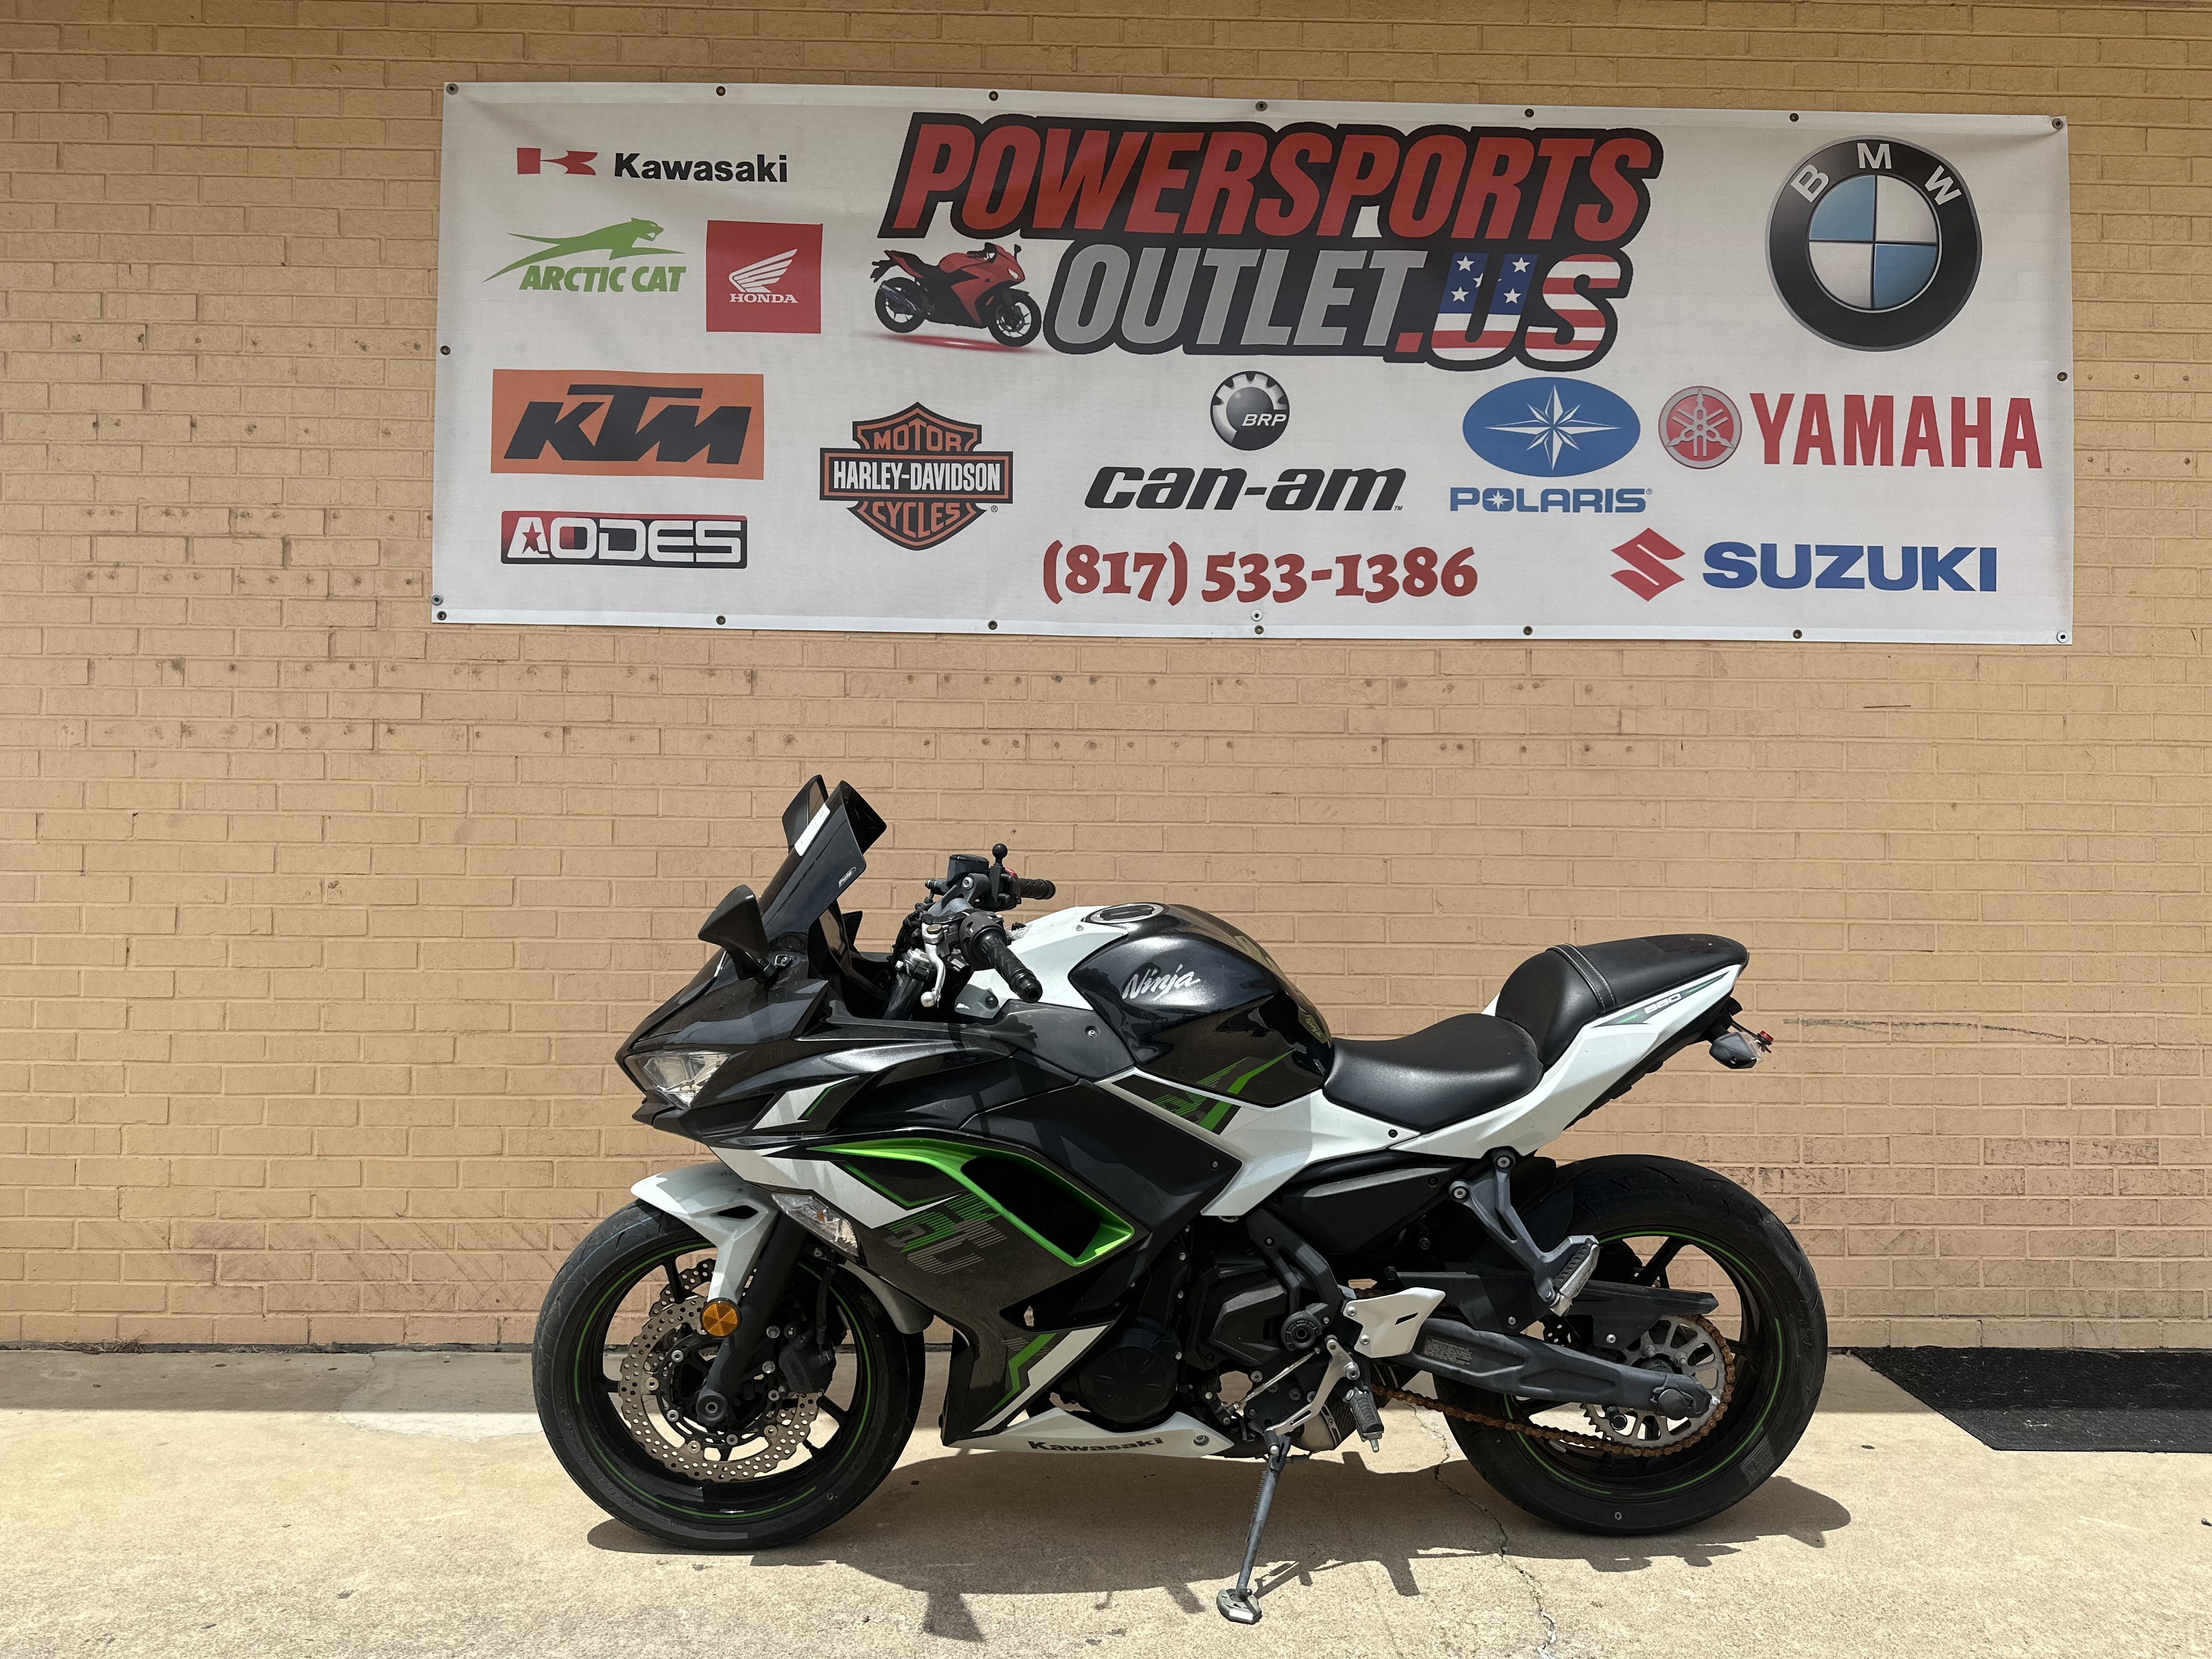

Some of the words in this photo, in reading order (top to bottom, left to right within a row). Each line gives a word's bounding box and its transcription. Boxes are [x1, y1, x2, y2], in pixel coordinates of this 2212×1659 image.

[614, 152, 788, 183] Kawasaki
[890, 121, 1655, 243] POWERSPORTS
[1790, 143, 1962, 205] BMW
[519, 265, 627, 292] ARCTIC
[631, 266, 687, 292] CAT
[729, 292, 799, 304] HONDA
[1052, 243, 1625, 363] OUTLET.US
[503, 384, 752, 465] KTM
[873, 418, 962, 452] MOTOR
[1241, 413, 1287, 427] BRP
[1750, 393, 2042, 469] YAMAHA
[833, 460, 1001, 492] HARLEY-DAVIDSON
[1450, 487, 1645, 514] POLARIS
[872, 501, 961, 539] CYCLES
[506, 516, 742, 563] AODES
[1043, 540, 1188, 606] (817)
[1201, 546, 1478, 604] 533-1386
[1702, 541, 1997, 592] SUZUKI
[1121, 964, 1201, 1001] Ninja
[1027, 1437, 1164, 1452] Kawasaki
